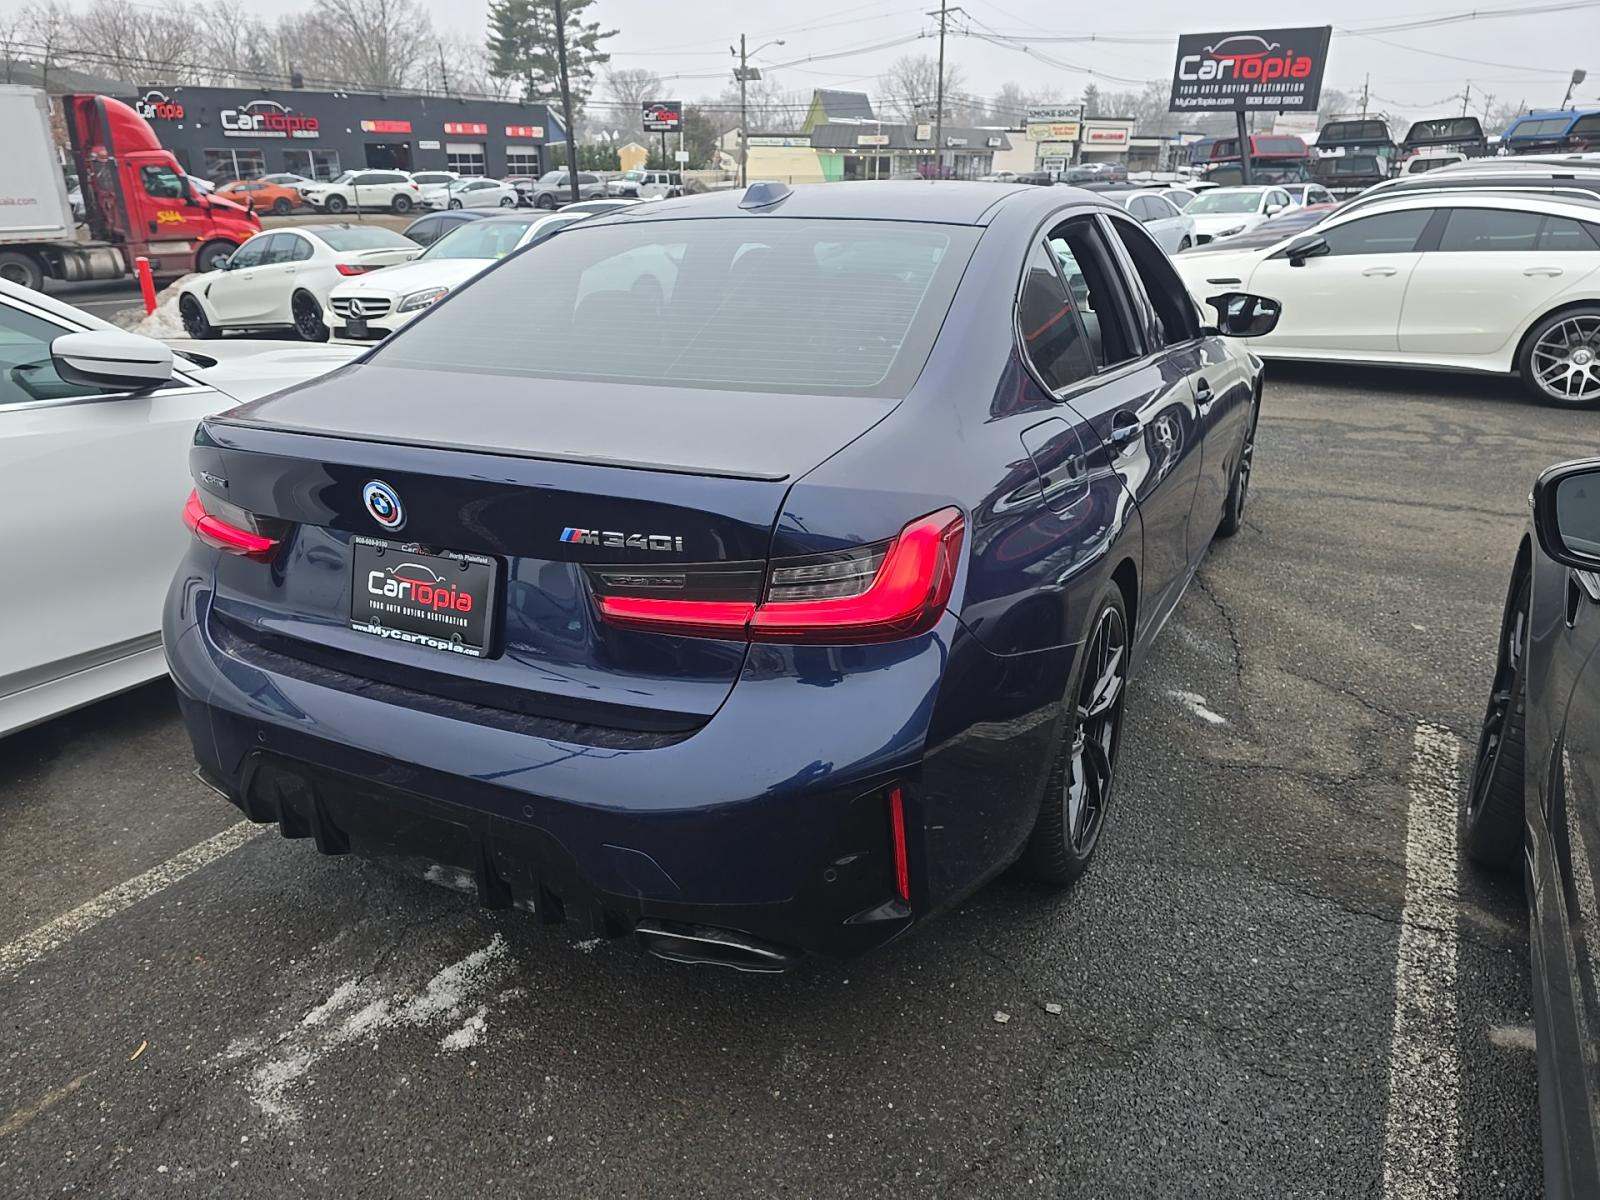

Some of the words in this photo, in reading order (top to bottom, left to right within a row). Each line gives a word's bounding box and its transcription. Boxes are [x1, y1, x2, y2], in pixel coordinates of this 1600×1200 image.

[1178, 50, 1312, 84] CarTopia
[1180, 85, 1198, 94] YOUR
[1201, 84, 1219, 94] AUTO
[1222, 84, 1250, 94] BUYING
[1252, 83, 1305, 93] DESTINATION
[135, 101, 184, 120] CarTopia
[1028, 109, 1056, 118] SMOKE
[1058, 109, 1080, 118] SHOP
[1174, 97, 1235, 107] MyCarTopia.com
[220, 109, 320, 139] CarTopia
[570, 528, 683, 552] M340i
[449, 552, 464, 561] North
[464, 554, 488, 564] Plainfield
[368, 570, 472, 612] CarTopia
[369, 599, 384, 610] YOUR
[386, 603, 401, 614] AUTO
[403, 606, 425, 619] BUYING
[427, 611, 468, 627] DESTINATION
[352, 623, 480, 657] www.MyCarTopia.com
